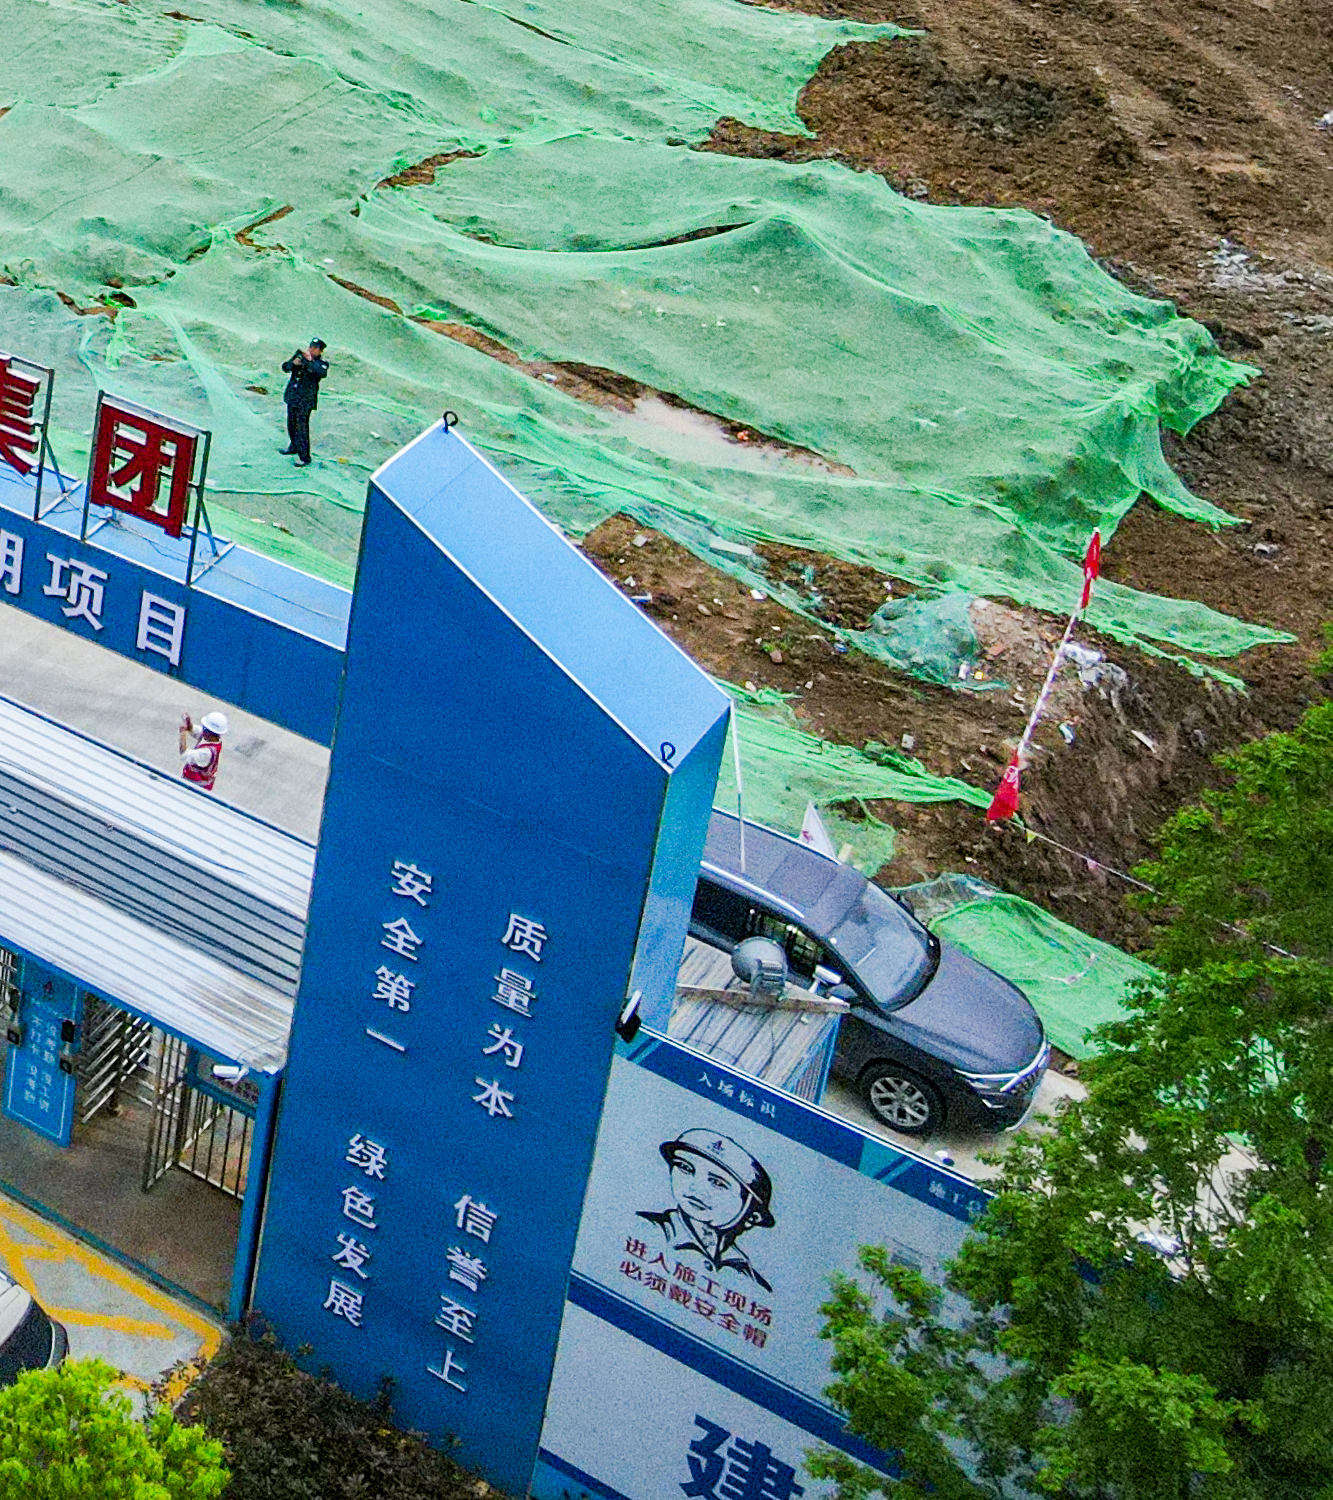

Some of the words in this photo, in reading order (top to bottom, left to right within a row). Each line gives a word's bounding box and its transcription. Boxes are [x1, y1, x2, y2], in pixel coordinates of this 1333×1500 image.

[365, 859, 435, 1055] 安全第一
[472, 913, 549, 1120] 质量为本
[322, 1133, 387, 1327] 绿色发展
[427, 1194, 499, 1393] 信誉至上
[623, 1235, 773, 1327] 进入施工现场
